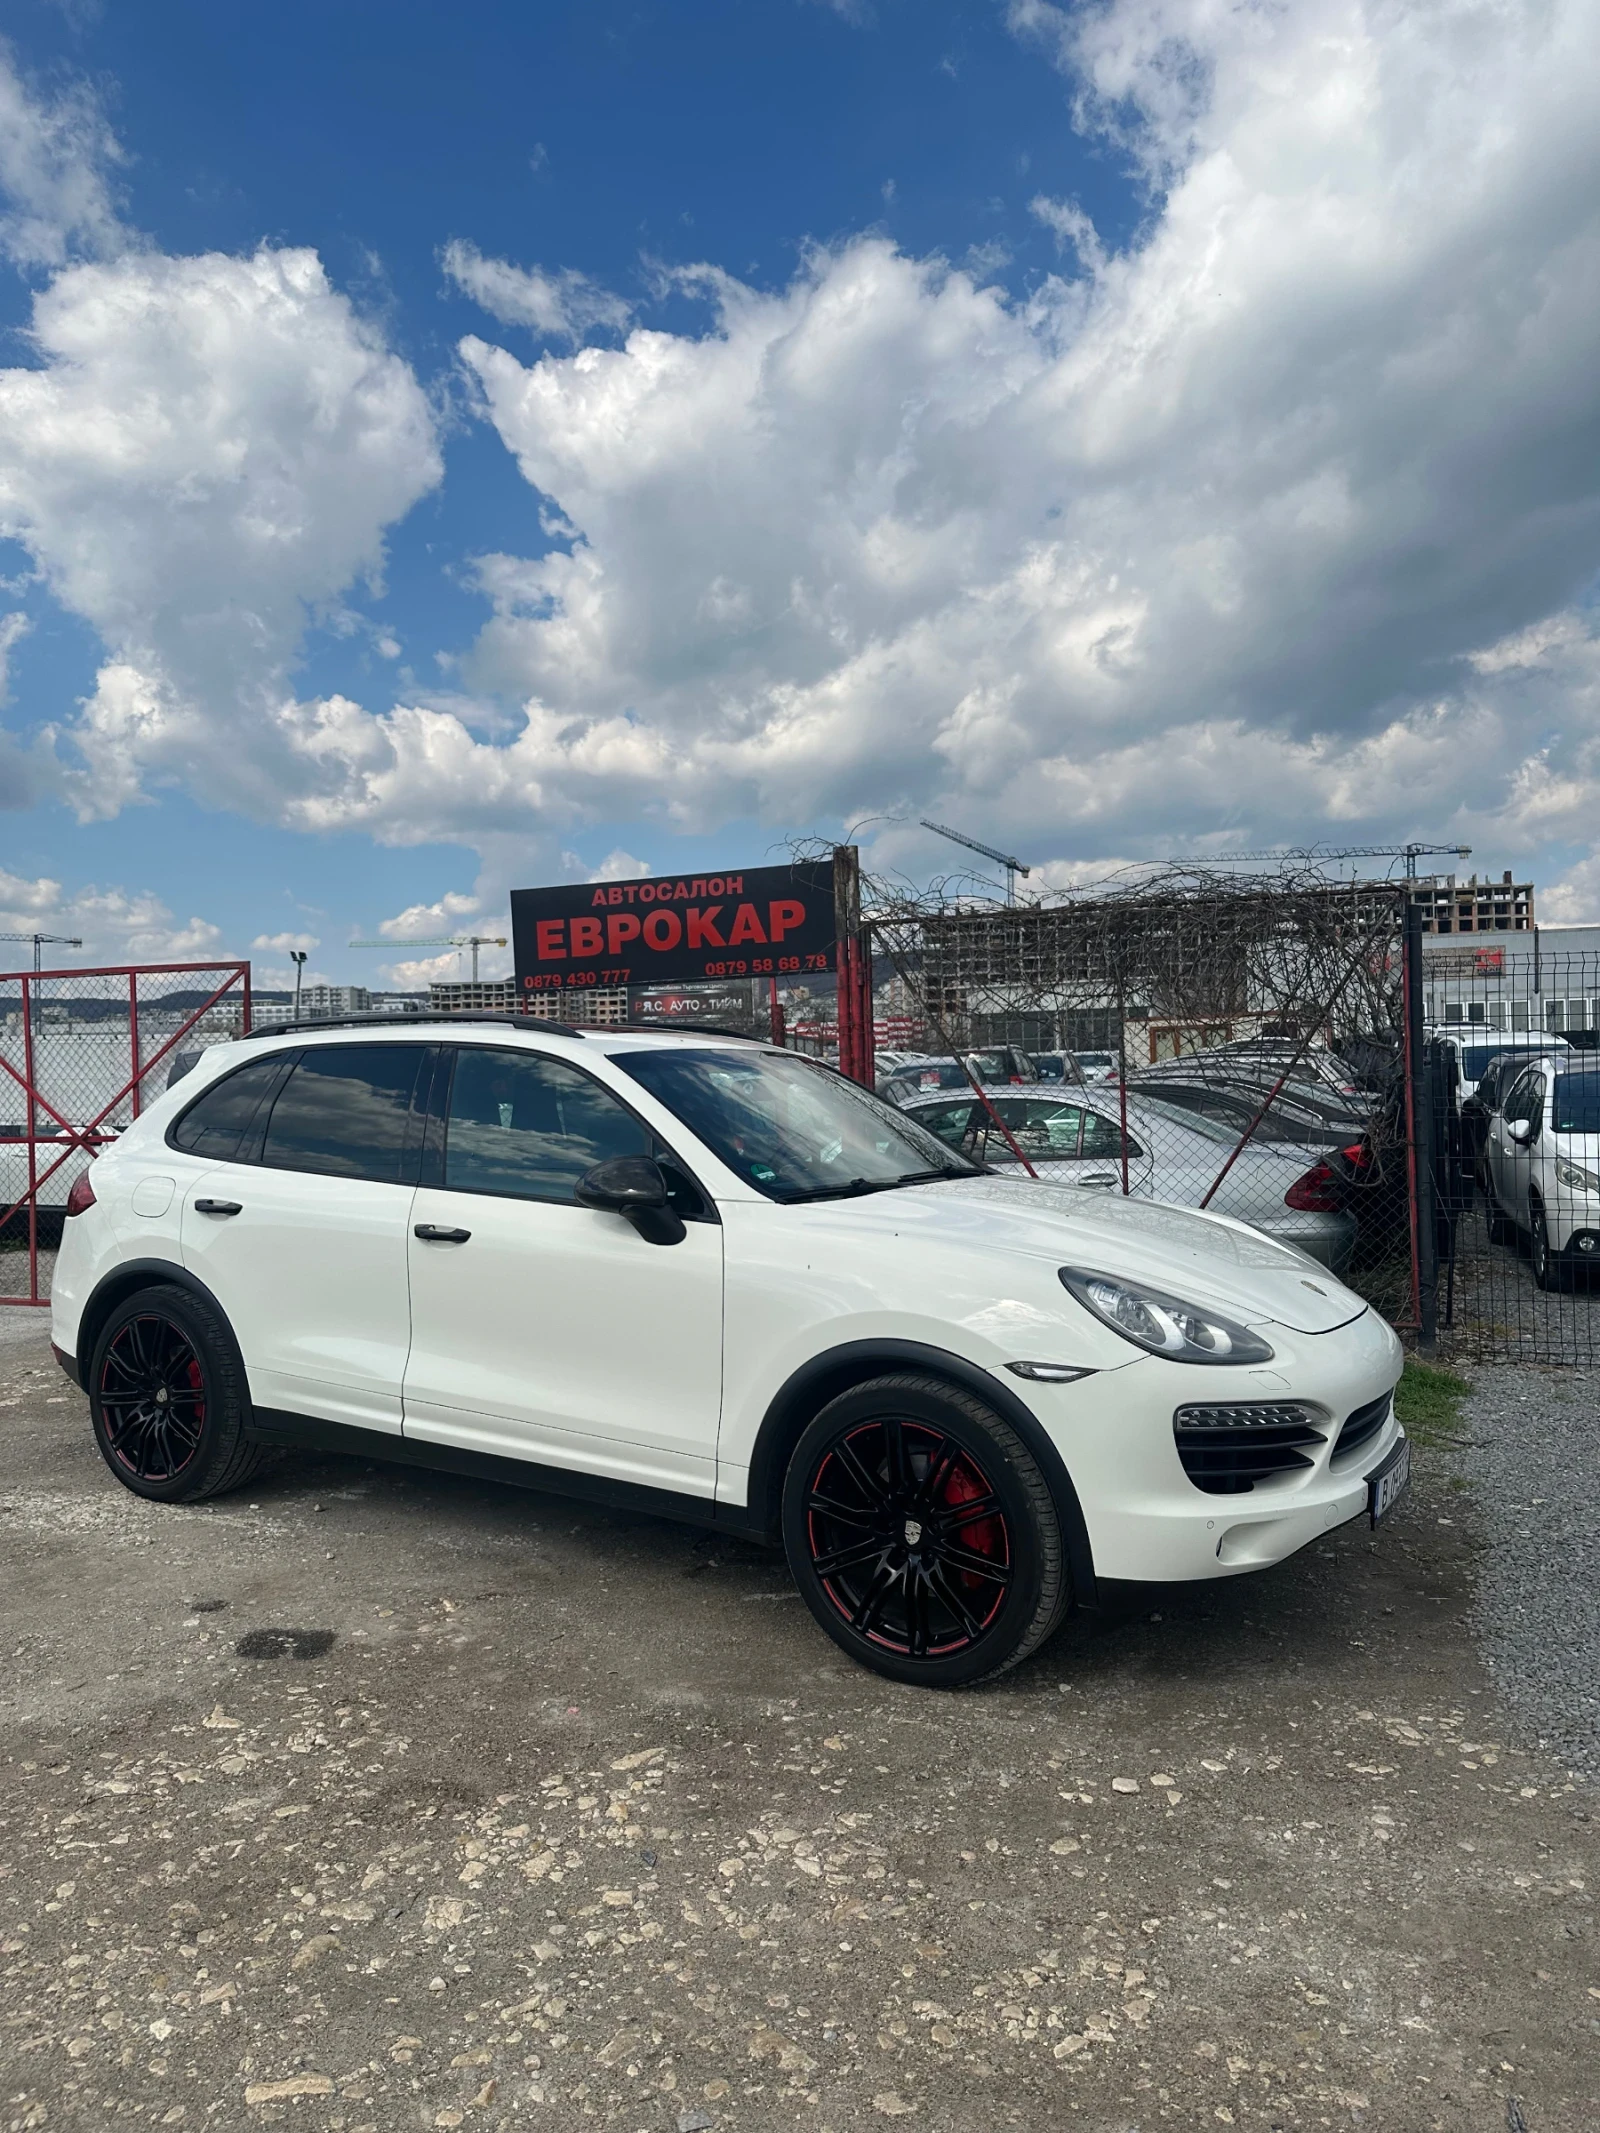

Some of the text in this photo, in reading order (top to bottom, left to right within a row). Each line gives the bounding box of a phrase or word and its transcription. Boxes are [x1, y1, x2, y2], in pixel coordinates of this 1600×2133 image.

[592, 876, 744, 906] АВТОСАЛОН
[536, 900, 806, 961] ЕВРОКАР
[705, 954, 828, 976] 0879 58 68 78
[524, 969, 632, 989] 0879 430 777
[670, 1000, 700, 1011] АУТО
